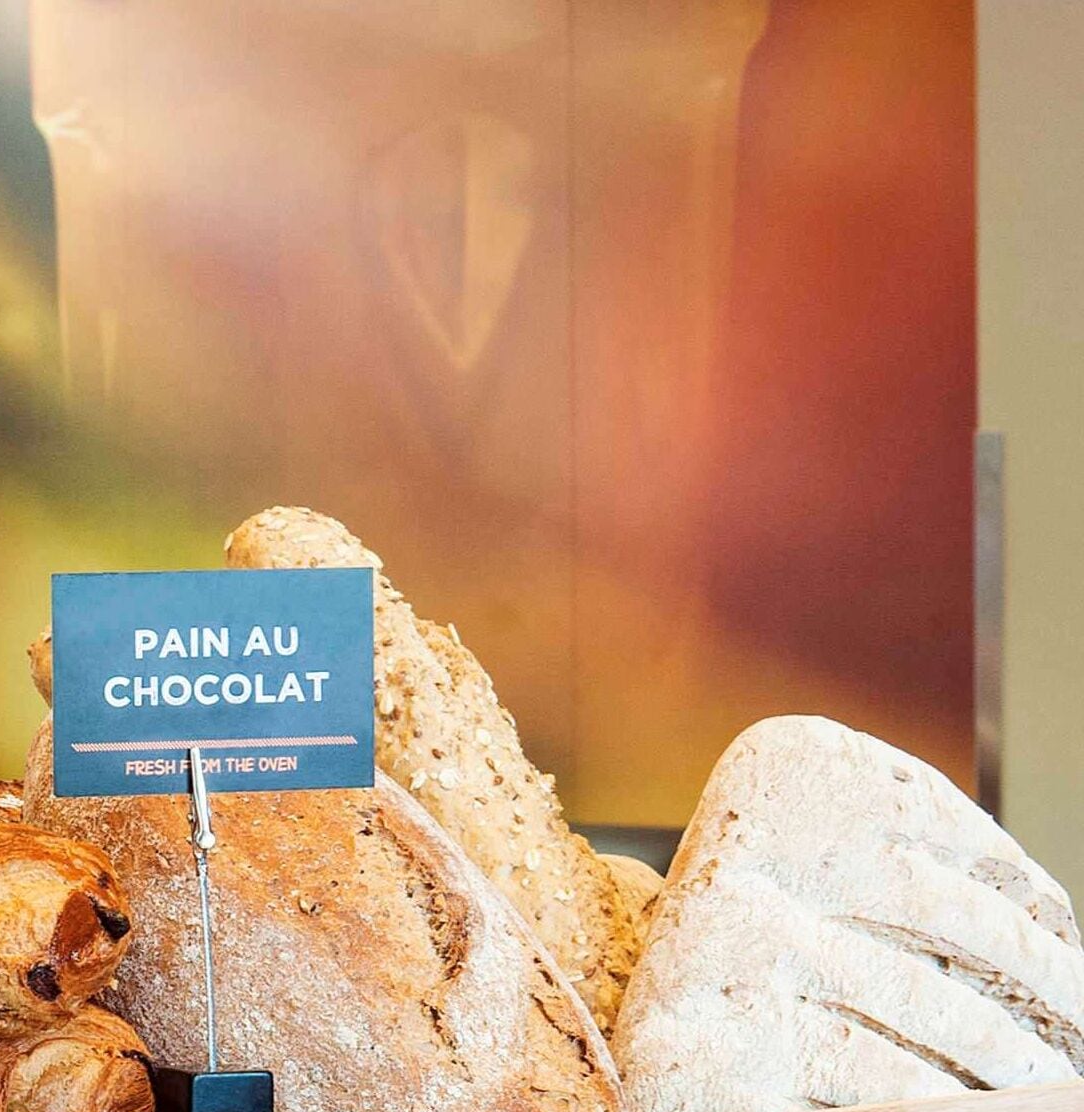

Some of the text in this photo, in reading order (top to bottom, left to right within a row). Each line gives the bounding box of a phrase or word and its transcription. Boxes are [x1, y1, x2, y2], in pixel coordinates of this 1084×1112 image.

[134, 626, 299, 659] PAIN AU
[104, 671, 330, 707] CHOCOLAT
[125, 756, 298, 776] FRESH FOM THE OVEN
